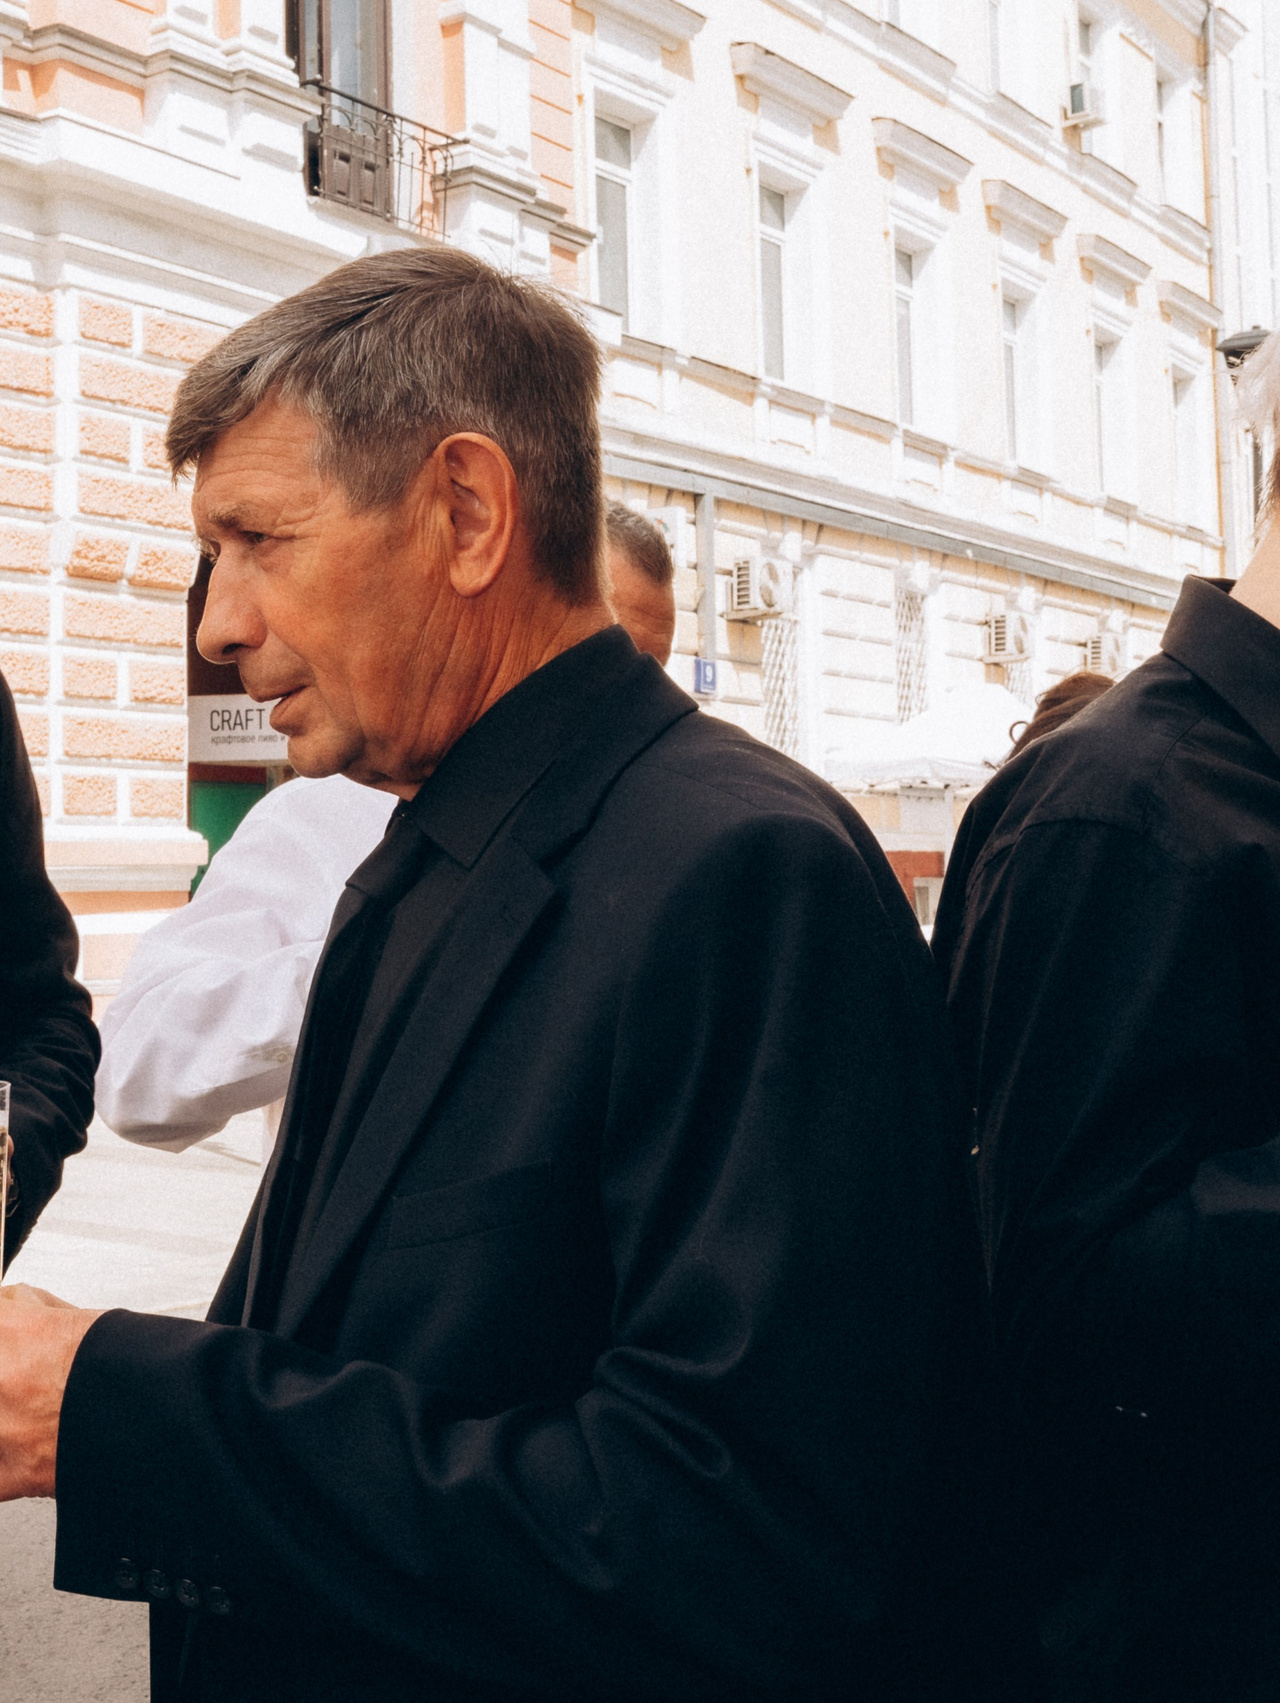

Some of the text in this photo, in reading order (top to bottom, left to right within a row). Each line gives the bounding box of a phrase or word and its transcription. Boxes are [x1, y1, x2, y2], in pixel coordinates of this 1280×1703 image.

[705, 665, 714, 683] 9
[210, 708, 266, 732] CRAFT
[211, 734, 255, 745] крафтовое
[258, 734, 278, 743] пиво
